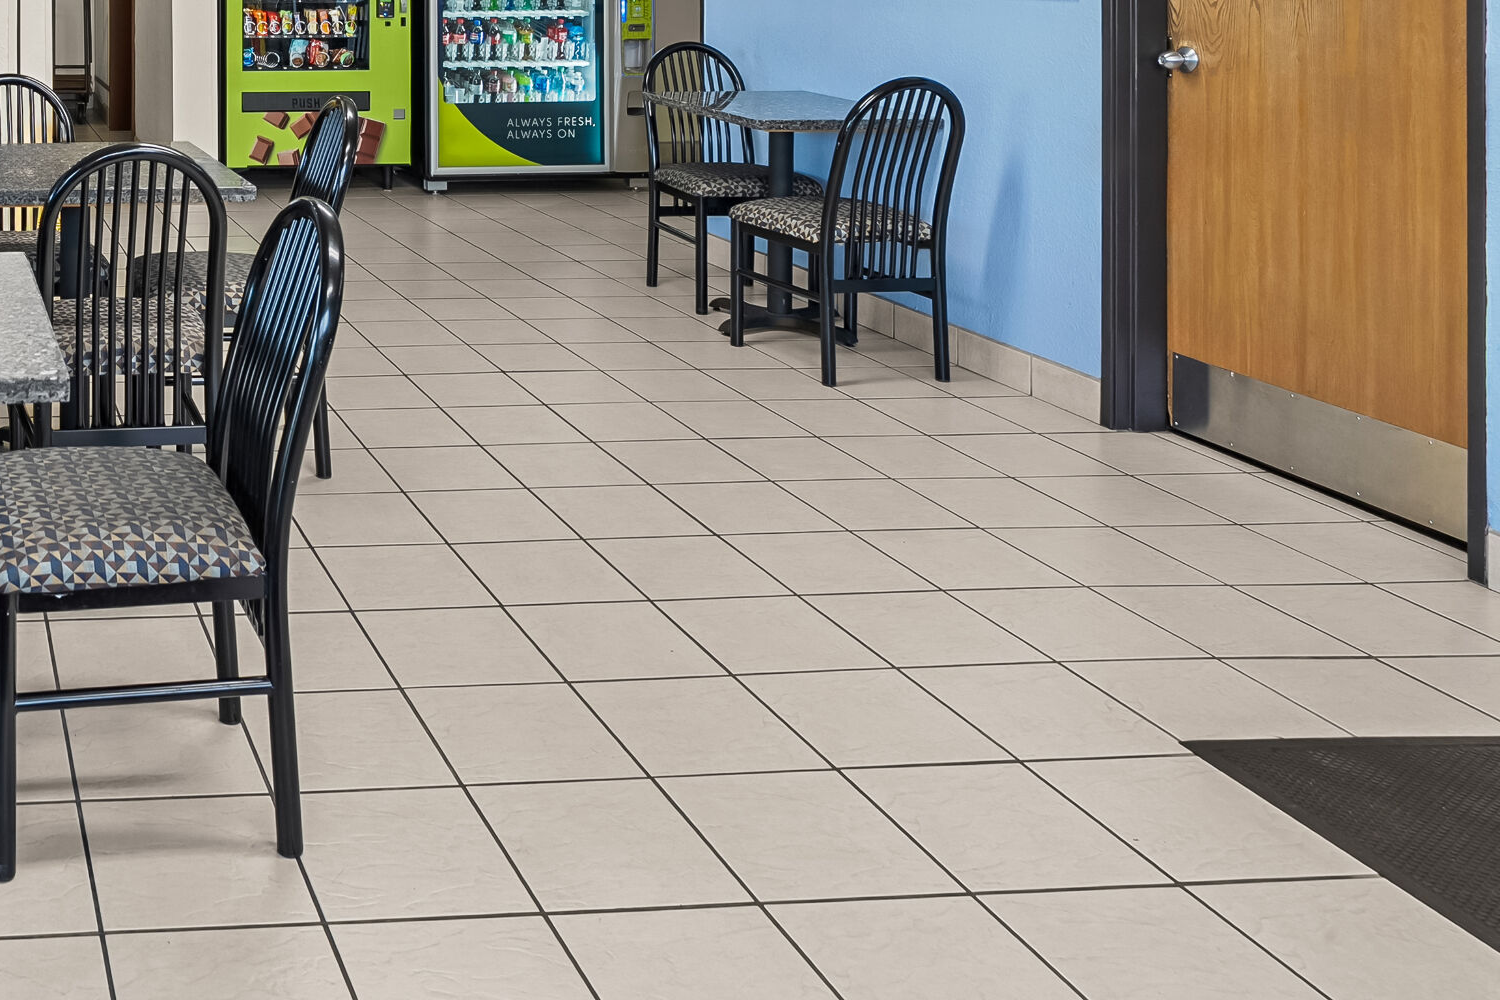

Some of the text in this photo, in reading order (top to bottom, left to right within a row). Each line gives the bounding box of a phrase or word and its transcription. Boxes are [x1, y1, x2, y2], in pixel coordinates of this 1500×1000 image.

[291, 97, 321, 109] PUSH
[506, 117, 553, 127] ALWAYS
[506, 128, 576, 140] ALWAYS ON
